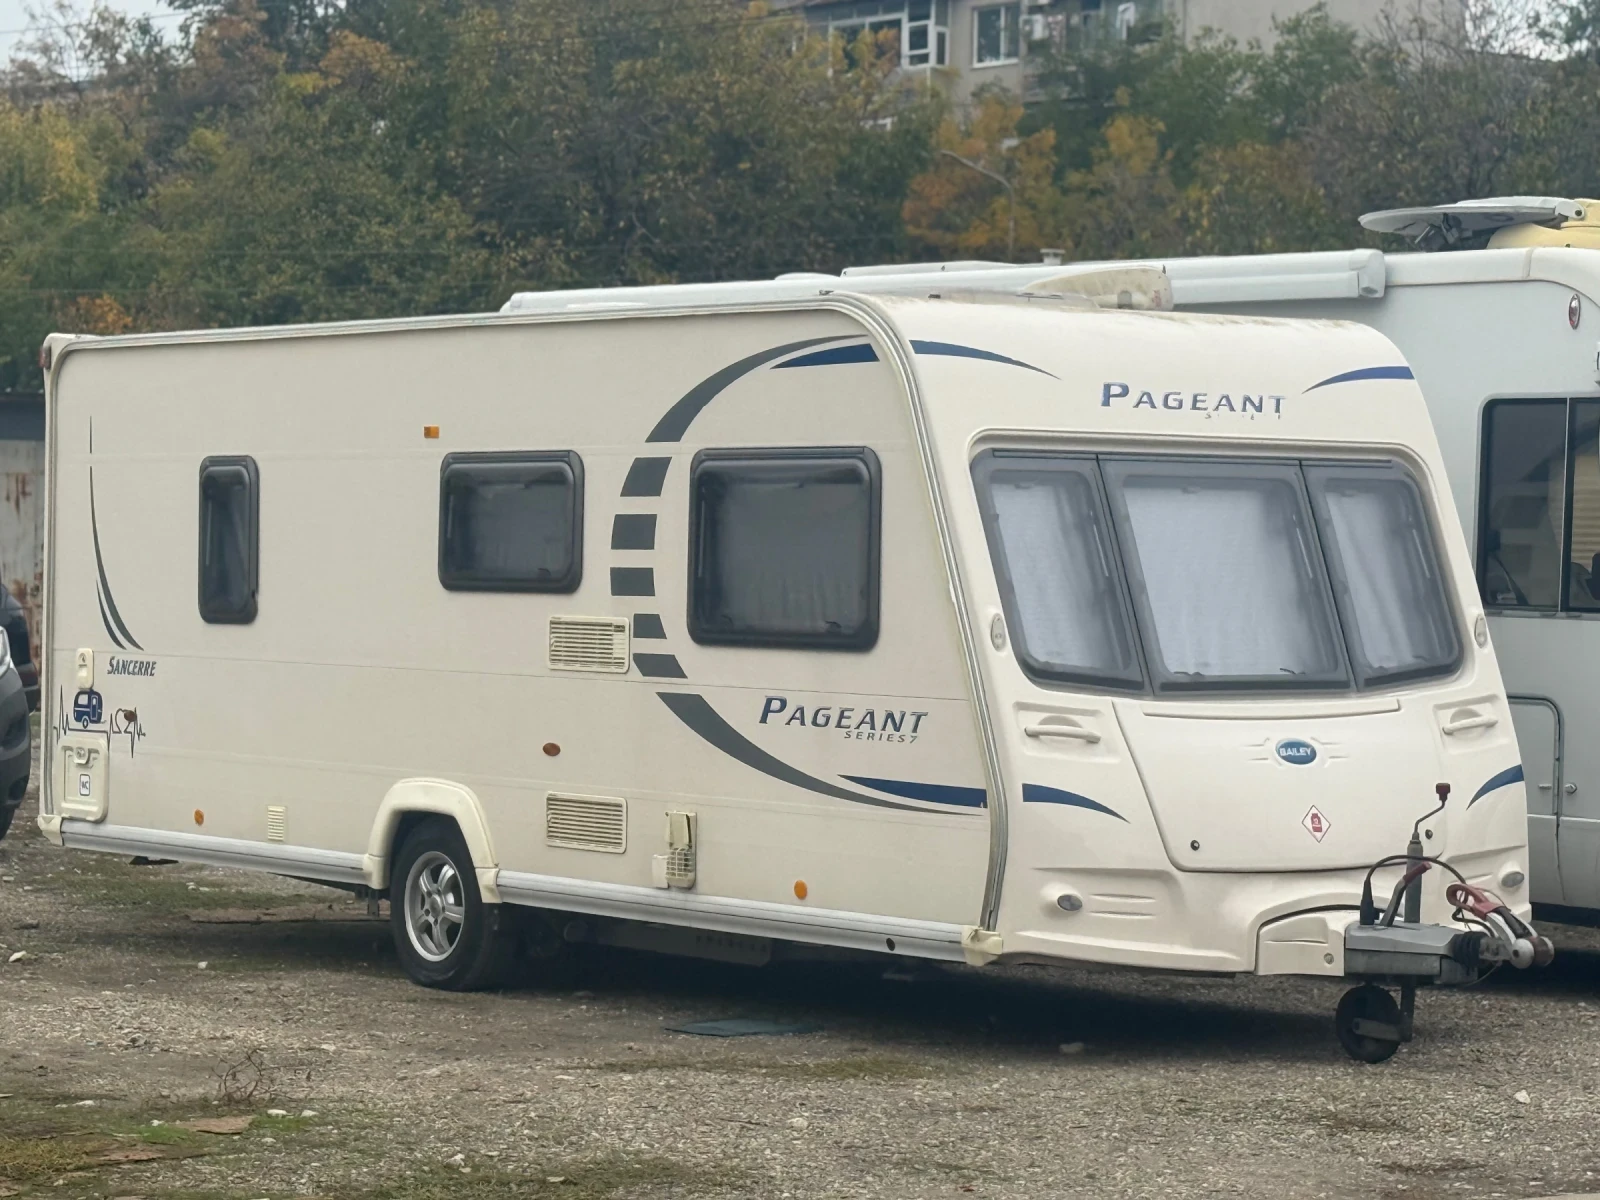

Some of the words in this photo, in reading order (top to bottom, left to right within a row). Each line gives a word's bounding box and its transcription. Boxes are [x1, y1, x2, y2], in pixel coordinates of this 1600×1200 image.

[1100, 382, 1287, 414] PAGEANT
[107, 656, 157, 677] SANCERRE
[758, 695, 929, 734] PAGEANT
[1279, 747, 1312, 757] BAILEY
